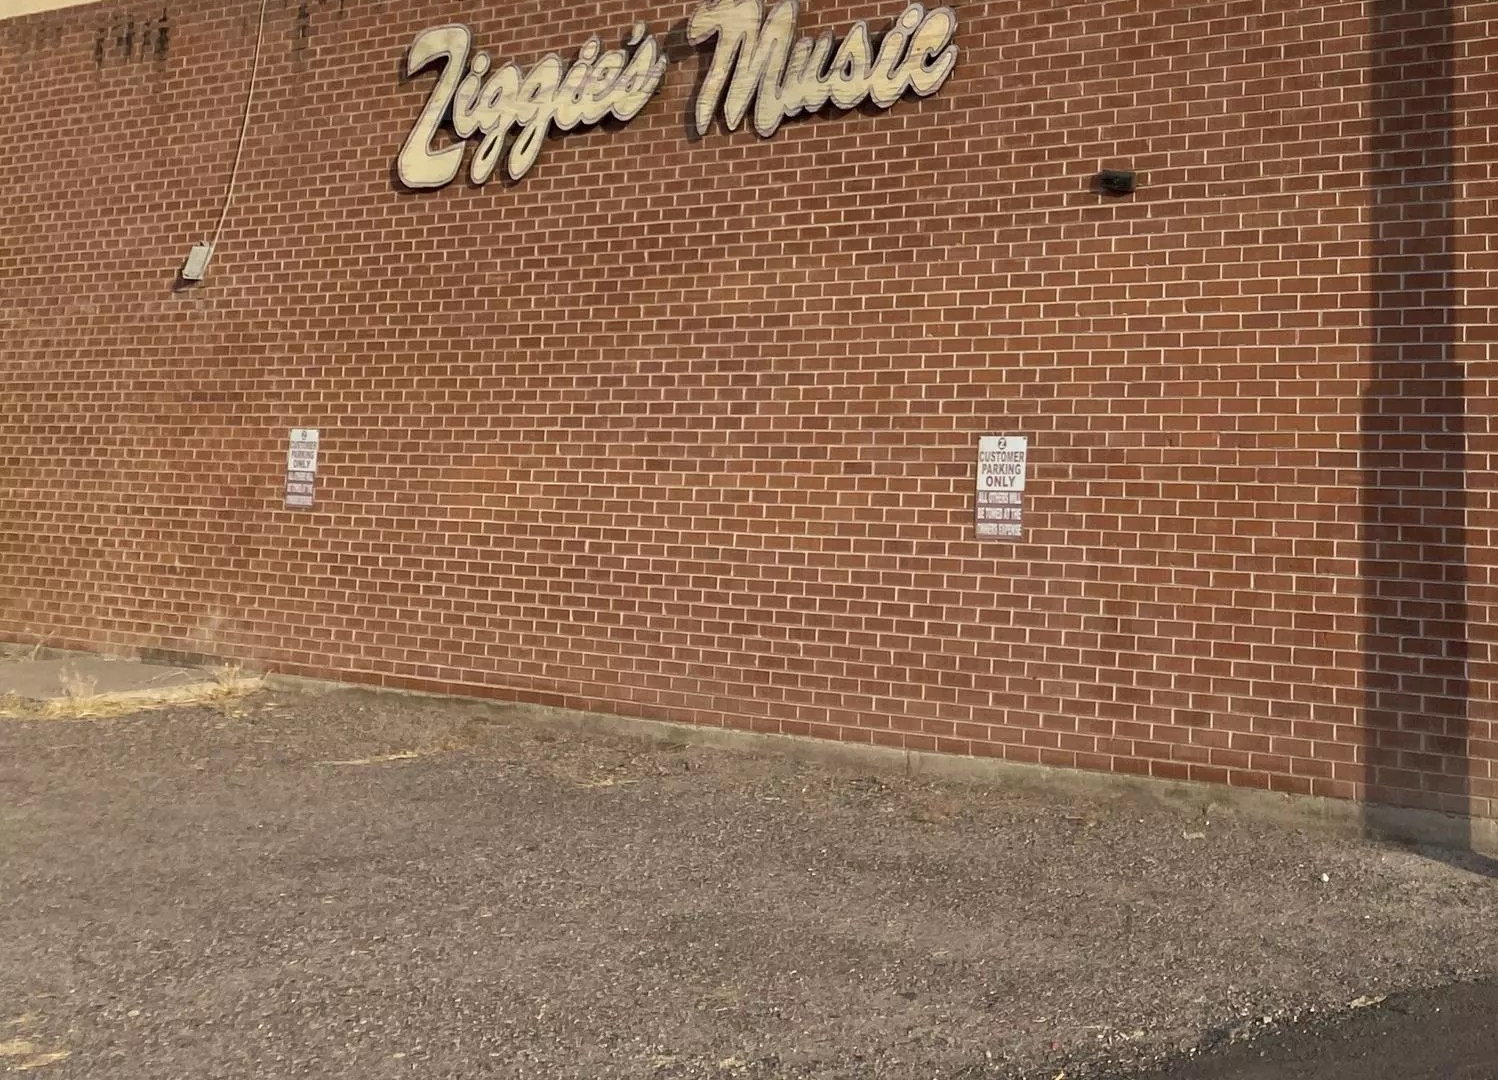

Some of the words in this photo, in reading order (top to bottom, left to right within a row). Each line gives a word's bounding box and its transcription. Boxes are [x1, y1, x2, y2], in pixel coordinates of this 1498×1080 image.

[398, 20, 667, 189] Ziggie's
[979, 451, 1025, 463] CUSTOMER
[982, 463, 1022, 475] PARKING
[986, 476, 1016, 488] ONLY
